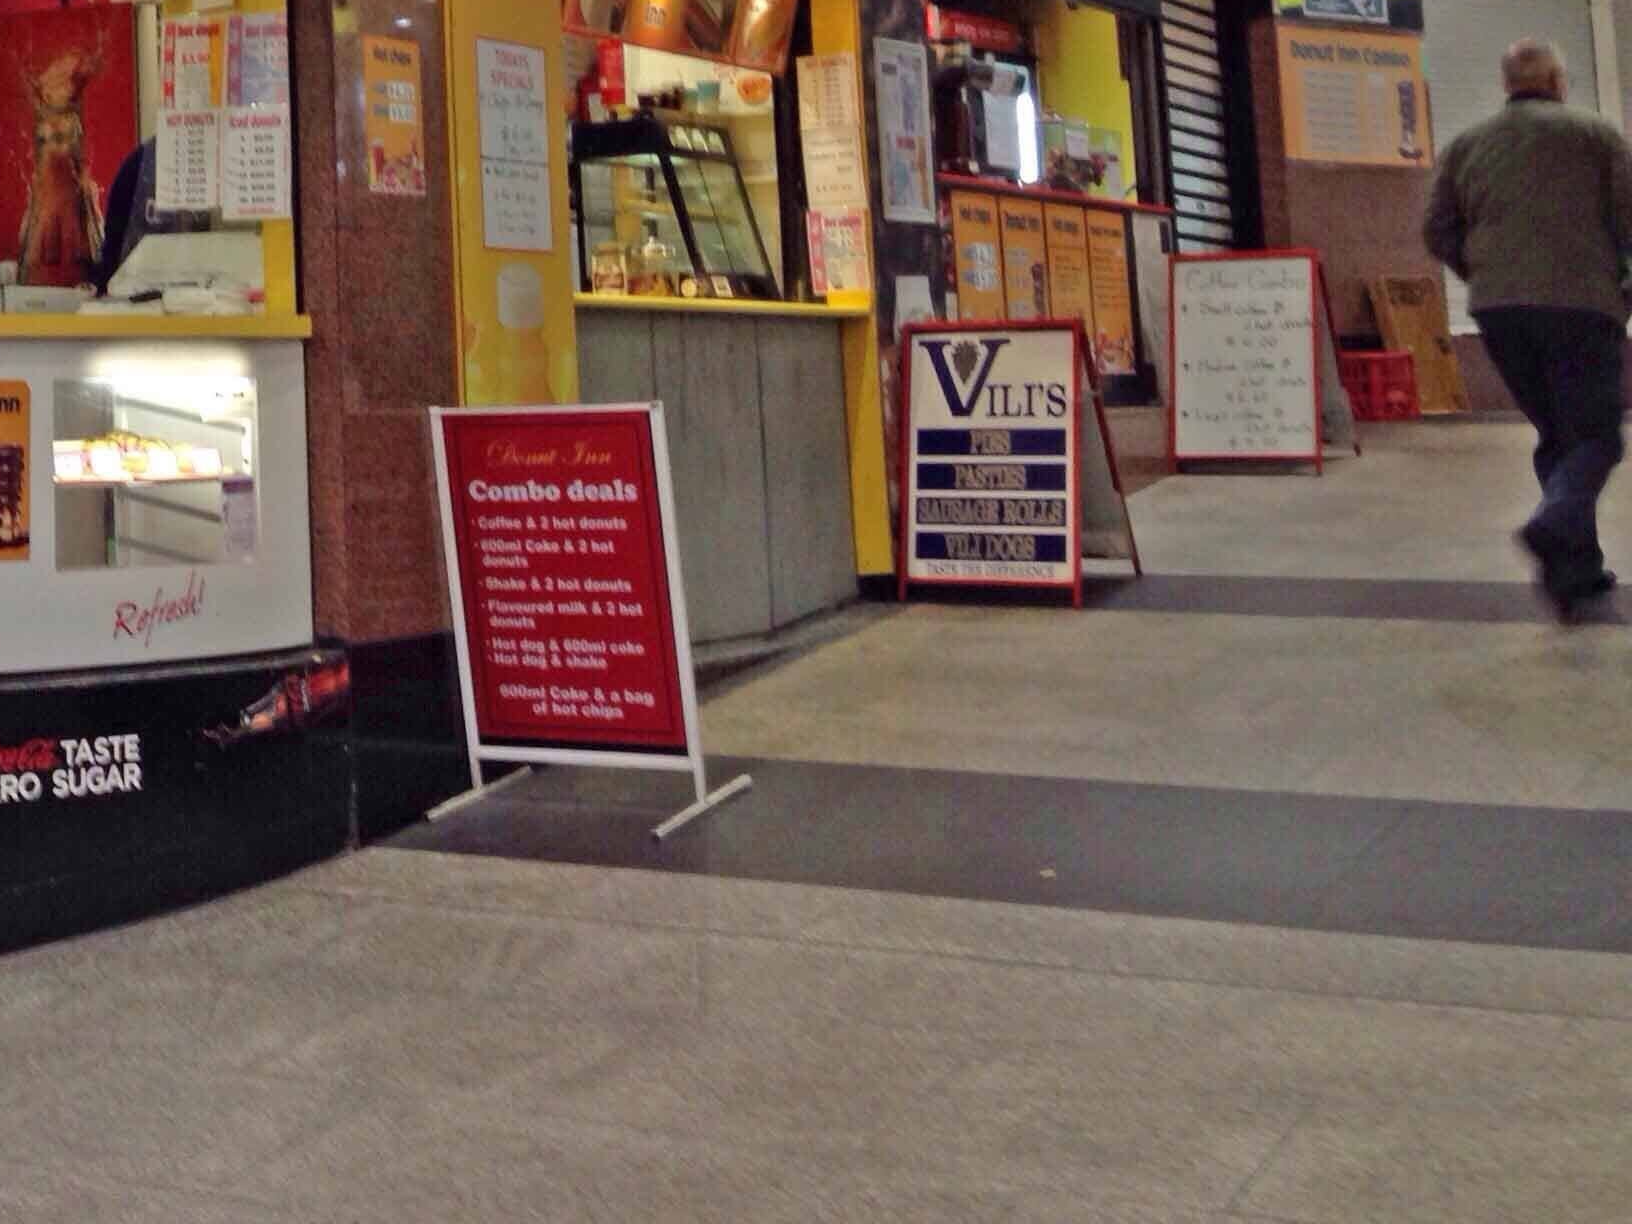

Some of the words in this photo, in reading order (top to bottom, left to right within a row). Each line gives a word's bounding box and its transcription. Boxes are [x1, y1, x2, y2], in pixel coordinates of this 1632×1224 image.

[919, 338, 1067, 418] VILI'S
[468, 479, 561, 503] Combo
[566, 479, 638, 503] deals
[1003, 499, 1064, 525] ROLLS
[478, 515, 522, 530] Coffee
[552, 516, 575, 530] hot
[579, 517, 628, 531] donuts
[525, 539, 560, 553] Coke
[591, 540, 616, 554] hot
[985, 533, 1036, 561] DOGS
[482, 555, 529, 569] donuts
[486, 577, 527, 591] Shake
[558, 578, 581, 592] hot
[584, 579, 632, 594] donuts
[488, 599, 555, 614] Flavoured
[558, 601, 588, 616] milk
[619, 602, 643, 617] hot
[489, 616, 536, 629] donuts
[492, 636, 517, 651] Hot
[520, 637, 546, 654] dog
[609, 642, 646, 656] coke
[494, 653, 518, 666] Hot
[522, 654, 547, 670] dog
[566, 655, 608, 670] shake
[550, 685, 589, 701] Coke
[624, 690, 656, 708] bag
[532, 702, 547, 715] of
[551, 702, 578, 716] hot
[581, 704, 624, 719] chips
[59, 733, 141, 765] TASTE
[51, 762, 144, 799] SUGAR
